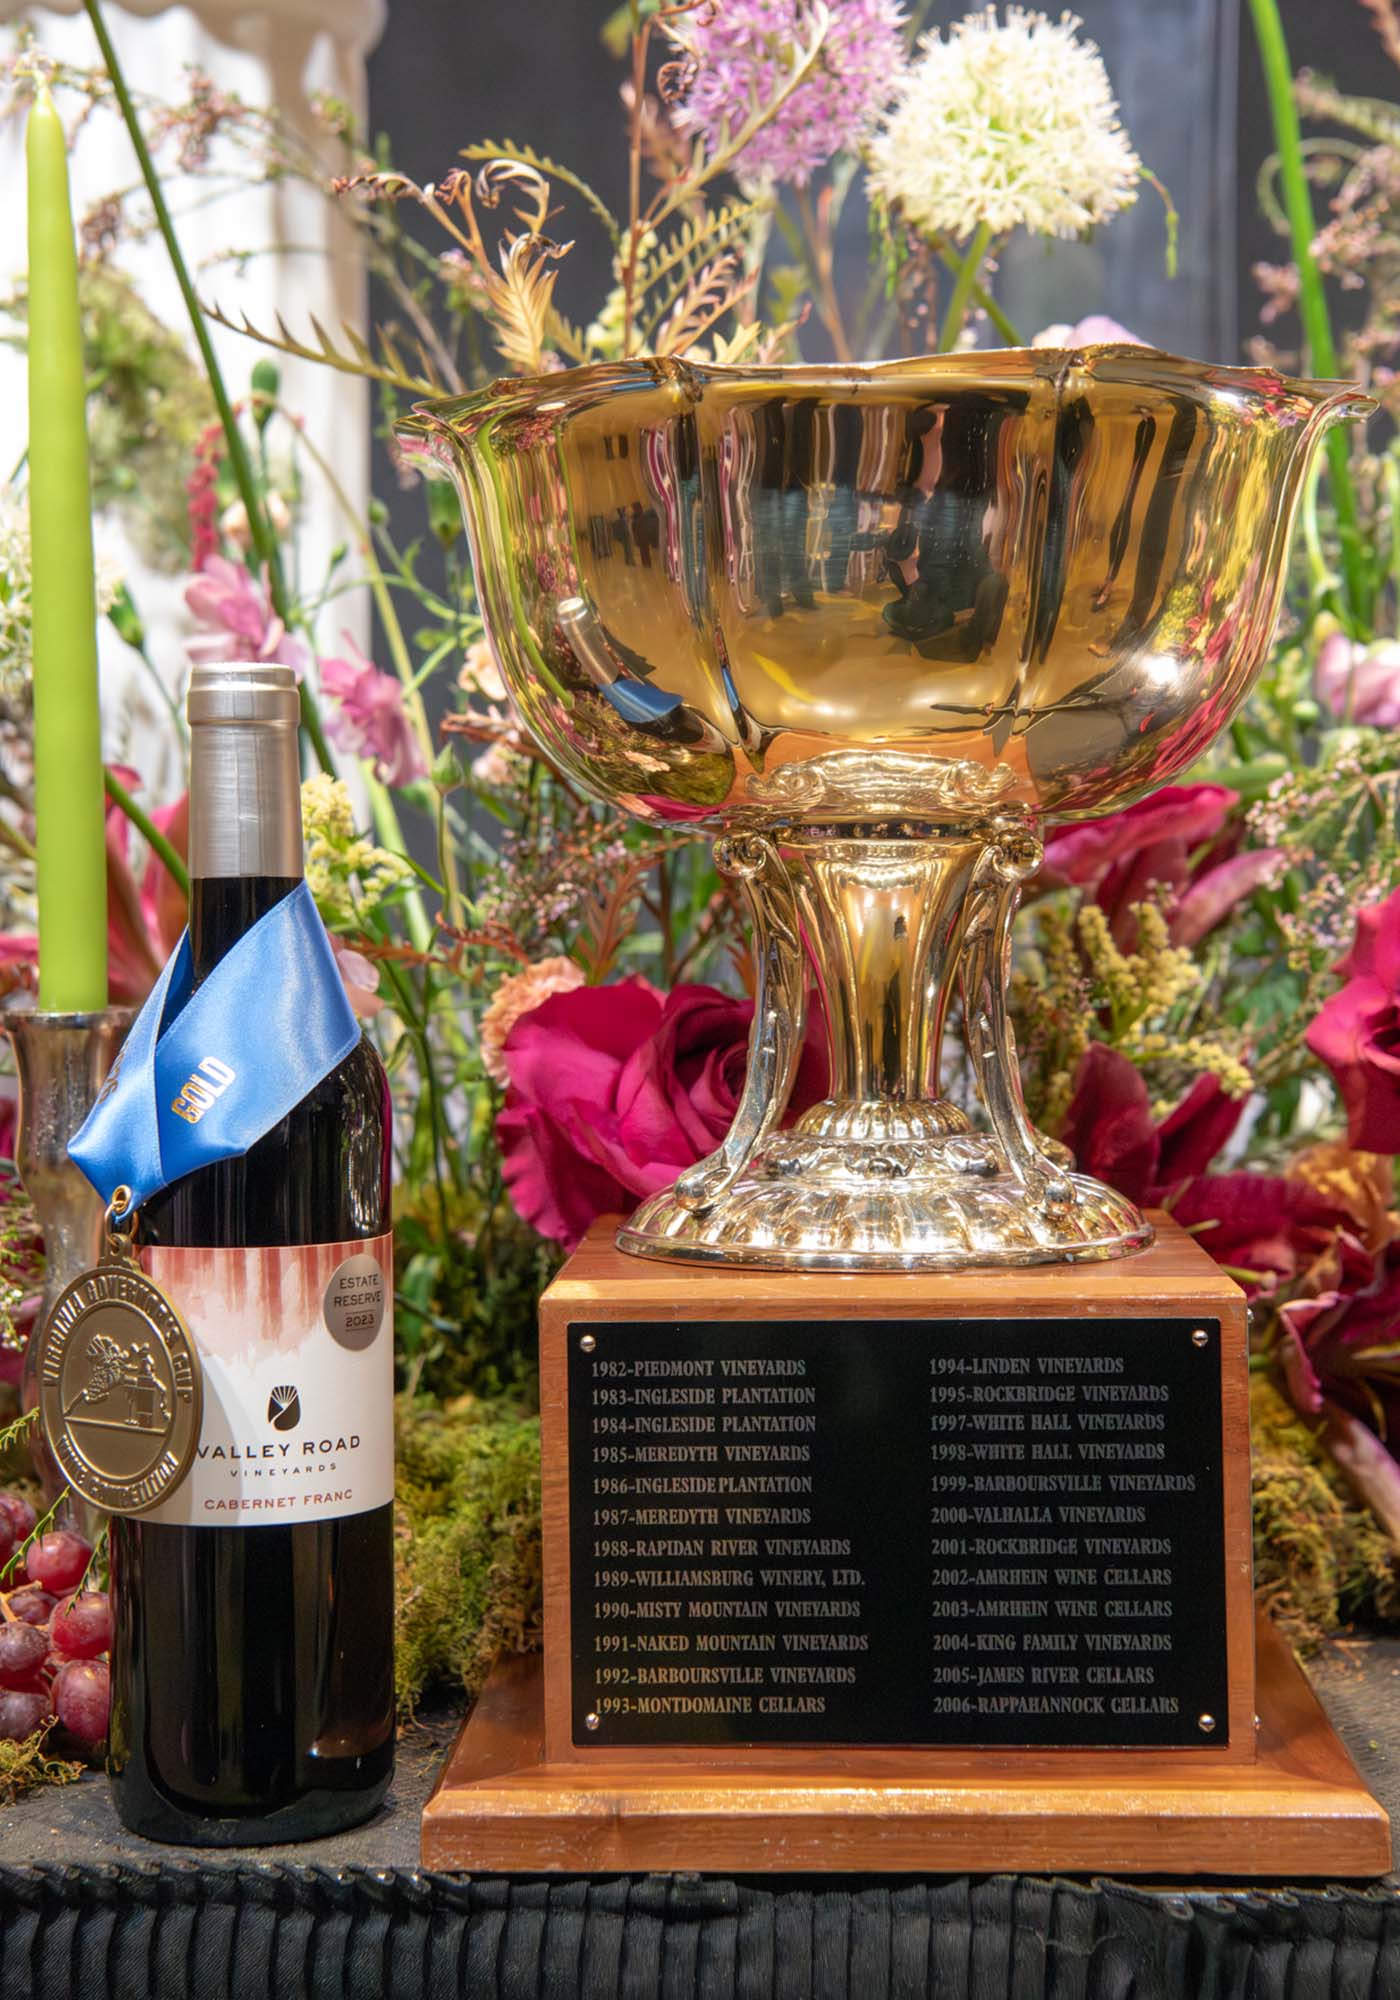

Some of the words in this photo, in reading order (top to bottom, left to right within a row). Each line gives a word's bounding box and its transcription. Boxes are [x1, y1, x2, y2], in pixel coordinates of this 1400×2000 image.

[171, 1056, 236, 1125] GOLD
[339, 1273, 380, 1290] ESTATE
[333, 1290, 382, 1307] RESERVE
[345, 1313, 375, 1328] 2023
[591, 1360, 714, 1377] 1982-PIEDMONT
[721, 1360, 806, 1376] VINEYARDS
[929, 1358, 1030, 1374] 1994-LINDEN
[1037, 1357, 1124, 1374] VINEYARDS
[591, 1388, 715, 1405] 1983-INGLESIDE
[722, 1387, 815, 1404] PLANTATION
[929, 1386, 1076, 1403] 1995-ROCKBRIDGE
[1081, 1385, 1170, 1402] VINEYARDS
[592, 1416, 715, 1434] 1984-INGLESIDE
[722, 1416, 816, 1432] PLANTATION
[930, 1415, 1024, 1432] 1997-WHITE
[1031, 1414, 1072, 1431] HALL
[1077, 1414, 1165, 1430] VINEYARDS
[197, 1442, 291, 1460] VALLEY
[302, 1435, 361, 1455] ROAD
[592, 1446, 718, 1463] 1985-MEREDYTH
[724, 1445, 811, 1462] VINEYARDS
[930, 1444, 1025, 1461] 1998-WHITE
[1031, 1444, 1072, 1461] HALL
[1078, 1443, 1166, 1460] VINEYARDS
[230, 1462, 337, 1478] VINEYARDS
[592, 1477, 717, 1495] 1986-INGLESIDE
[718, 1476, 813, 1493] PLANTATION
[930, 1475, 1102, 1492] 1999-BARBOURSVILLE
[1108, 1475, 1196, 1492] VINEYARDS
[204, 1496, 296, 1511] CABERNET
[303, 1489, 353, 1506] FRANC
[593, 1508, 718, 1526] 1987-MEREDYTH
[725, 1508, 812, 1525] VINEYARDS
[930, 1507, 1053, 1524] 2000-VALHALLA
[1058, 1506, 1146, 1523] VINEYARDS
[593, 1540, 705, 1558] 1988-RAPIDAN
[711, 1540, 758, 1556] RIVER
[765, 1539, 851, 1556] VINEYARDS
[931, 1538, 1078, 1555] 2001-ROCKBRIDGE
[1084, 1538, 1172, 1554] VINEYARDS
[593, 1569, 754, 1587] 1989-WILLIAMSBURG
[760, 1569, 826, 1588] WINERY,
[832, 1569, 865, 1586] LTD.
[931, 1569, 1048, 1586] 2002-AMRHEIN
[1054, 1569, 1097, 1585] WINE
[1103, 1568, 1172, 1585] CELLARS
[593, 1602, 682, 1619] 1990-MISTY
[688, 1601, 768, 1618] MOUNTAIN
[774, 1601, 861, 1618] VINEYARDS
[932, 1600, 1048, 1617] 2003-AMRHEIN
[1055, 1600, 1098, 1617] WINE
[1104, 1600, 1173, 1617] CELLARS
[593, 1635, 689, 1652] 1991-NAKED
[696, 1635, 776, 1652] MOUNTAIN
[782, 1634, 869, 1651] VINEYARDS
[933, 1634, 1016, 1652] 2004-KING
[1023, 1634, 1078, 1651] FAMILY
[1084, 1634, 1172, 1650] VINEYARDS
[594, 1667, 764, 1685] 1992-BARBOURSVILLE
[770, 1667, 856, 1684] VINEYARDS
[933, 1667, 1024, 1686] 2005-JAMES
[1031, 1667, 1080, 1684] RIVER
[1086, 1666, 1154, 1684] CELLARS
[595, 1697, 752, 1714] 1993-MONTDOMAINE
[758, 1697, 826, 1714] CELLARS
[933, 1697, 1105, 1713] 2006-RAPPAHANNOCK
[1111, 1696, 1179, 1713] CELLARS
